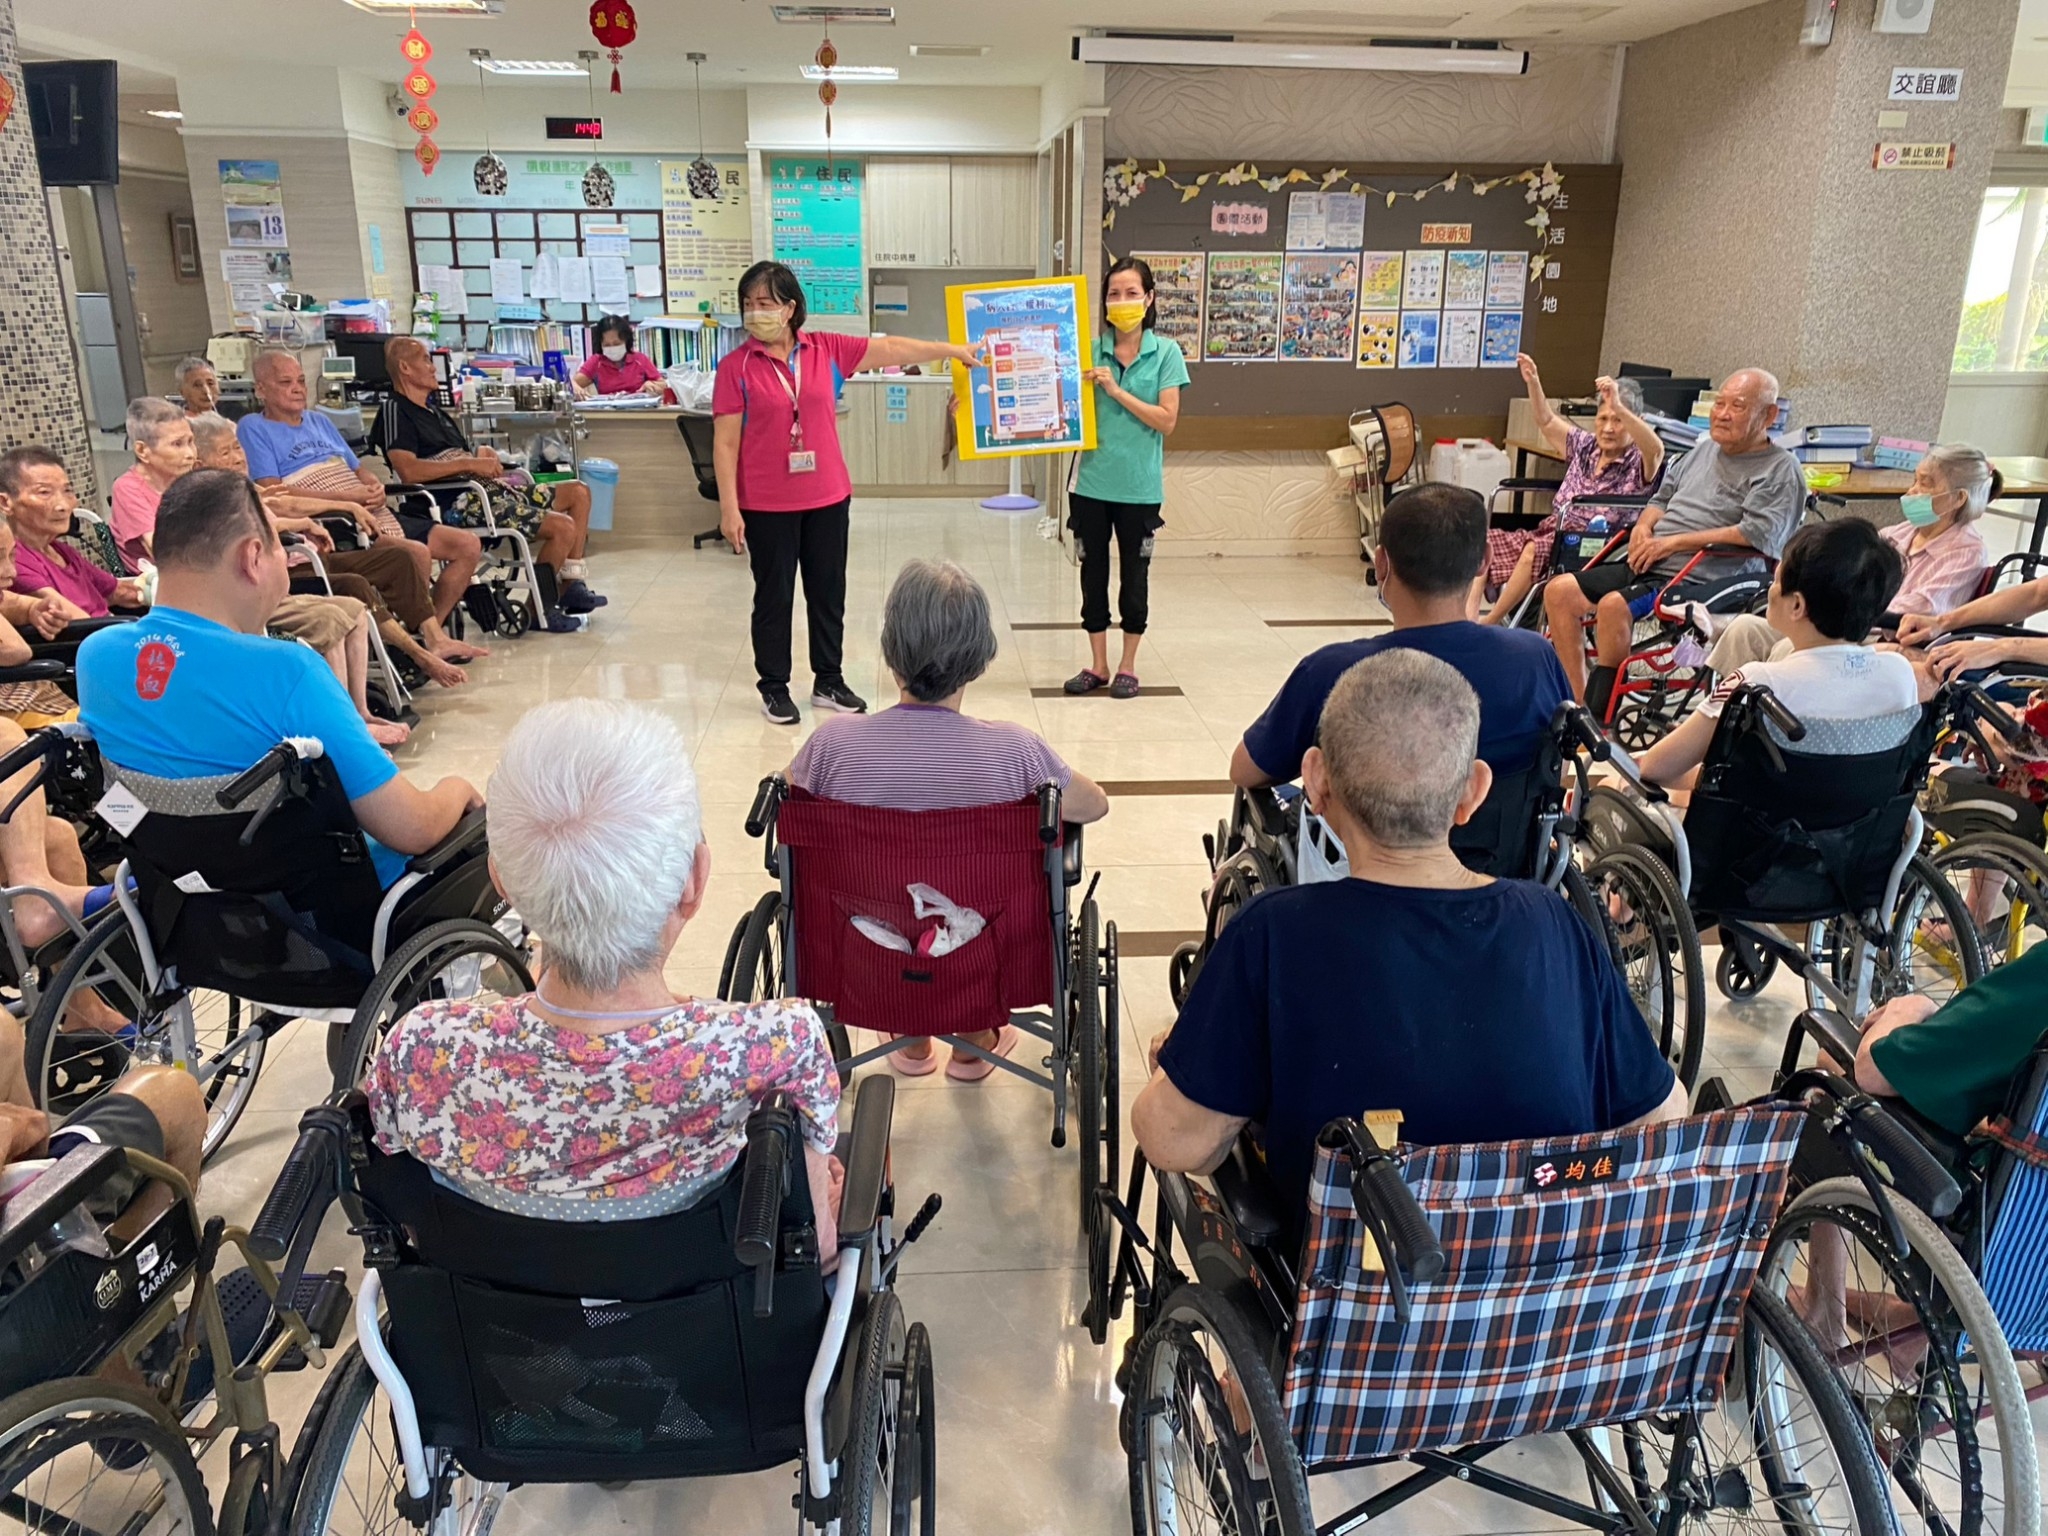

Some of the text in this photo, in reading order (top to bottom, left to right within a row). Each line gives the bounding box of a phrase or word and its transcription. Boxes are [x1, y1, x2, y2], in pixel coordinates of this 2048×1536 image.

[1894, 73, 1958, 95] 交誼廳
[263, 215, 283, 236] 13
[1422, 226, 1470, 242] 防疫新知
[1541, 192, 1569, 313] 生活園地
[1564, 1155, 1613, 1181] 均佳
[139, 1260, 178, 1303] KARMA
